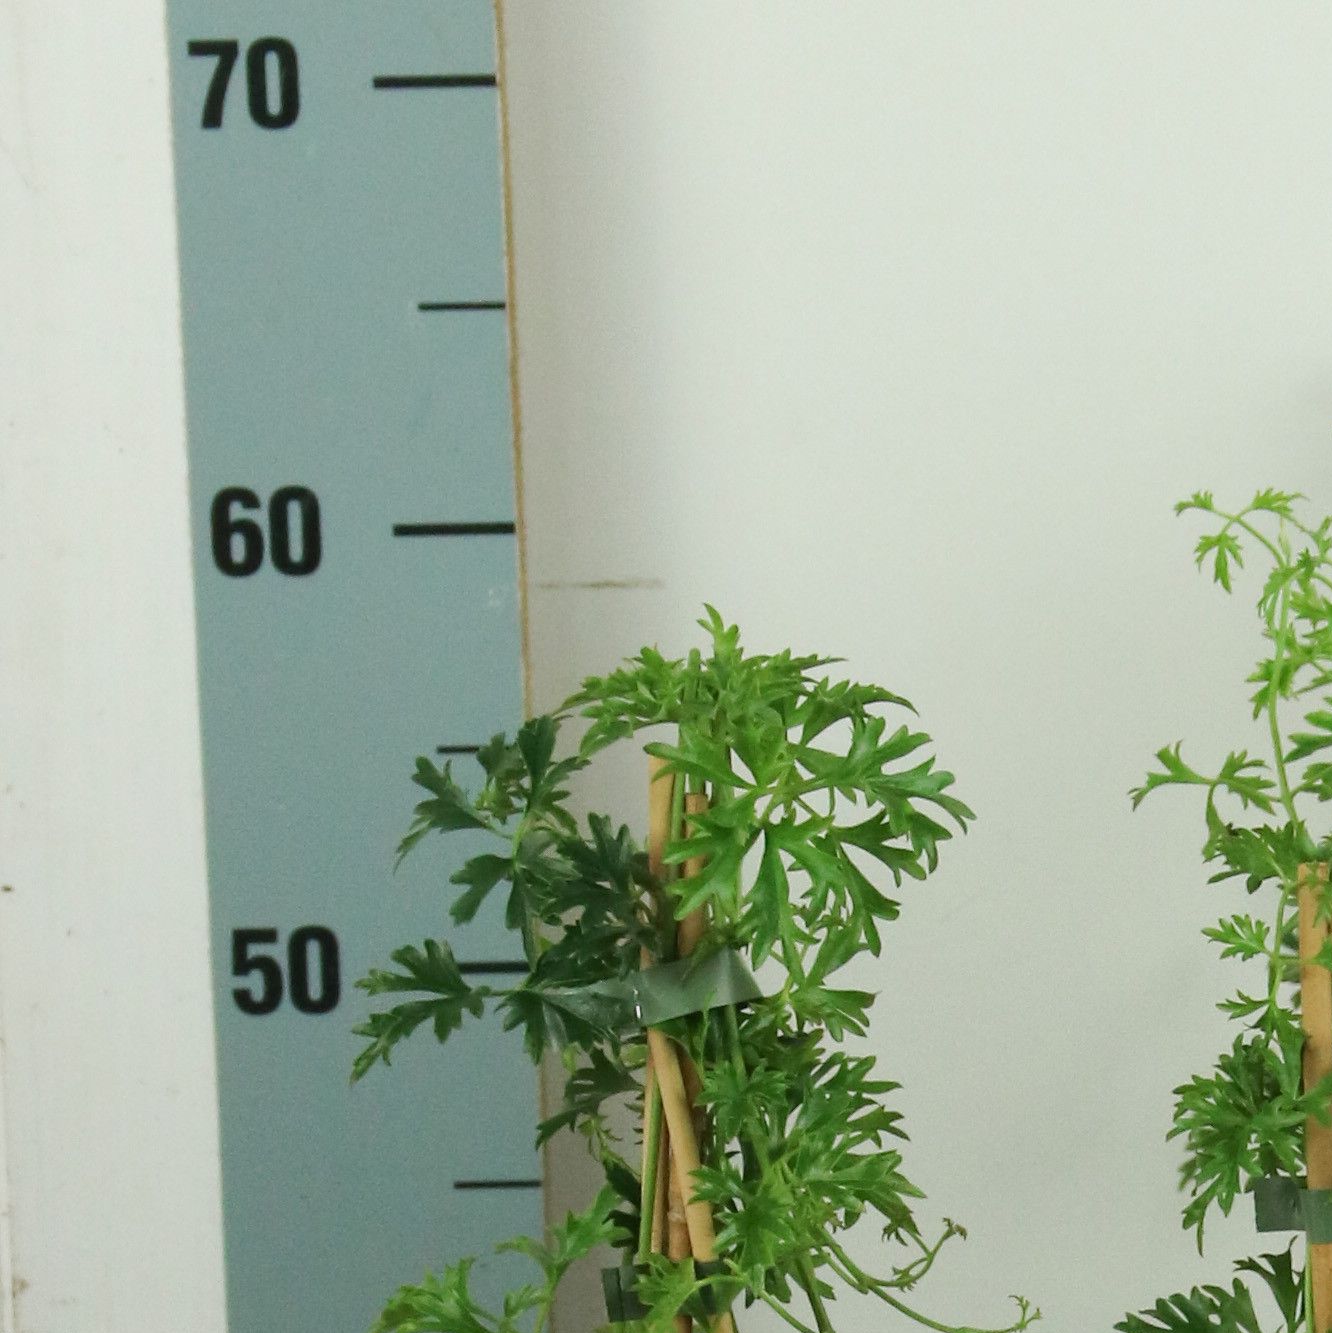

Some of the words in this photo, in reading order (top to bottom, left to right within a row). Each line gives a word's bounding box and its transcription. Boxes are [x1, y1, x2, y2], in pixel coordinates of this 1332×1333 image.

[188, 37, 300, 130] 70
[210, 486, 322, 578] 60
[232, 925, 341, 1016] 50
